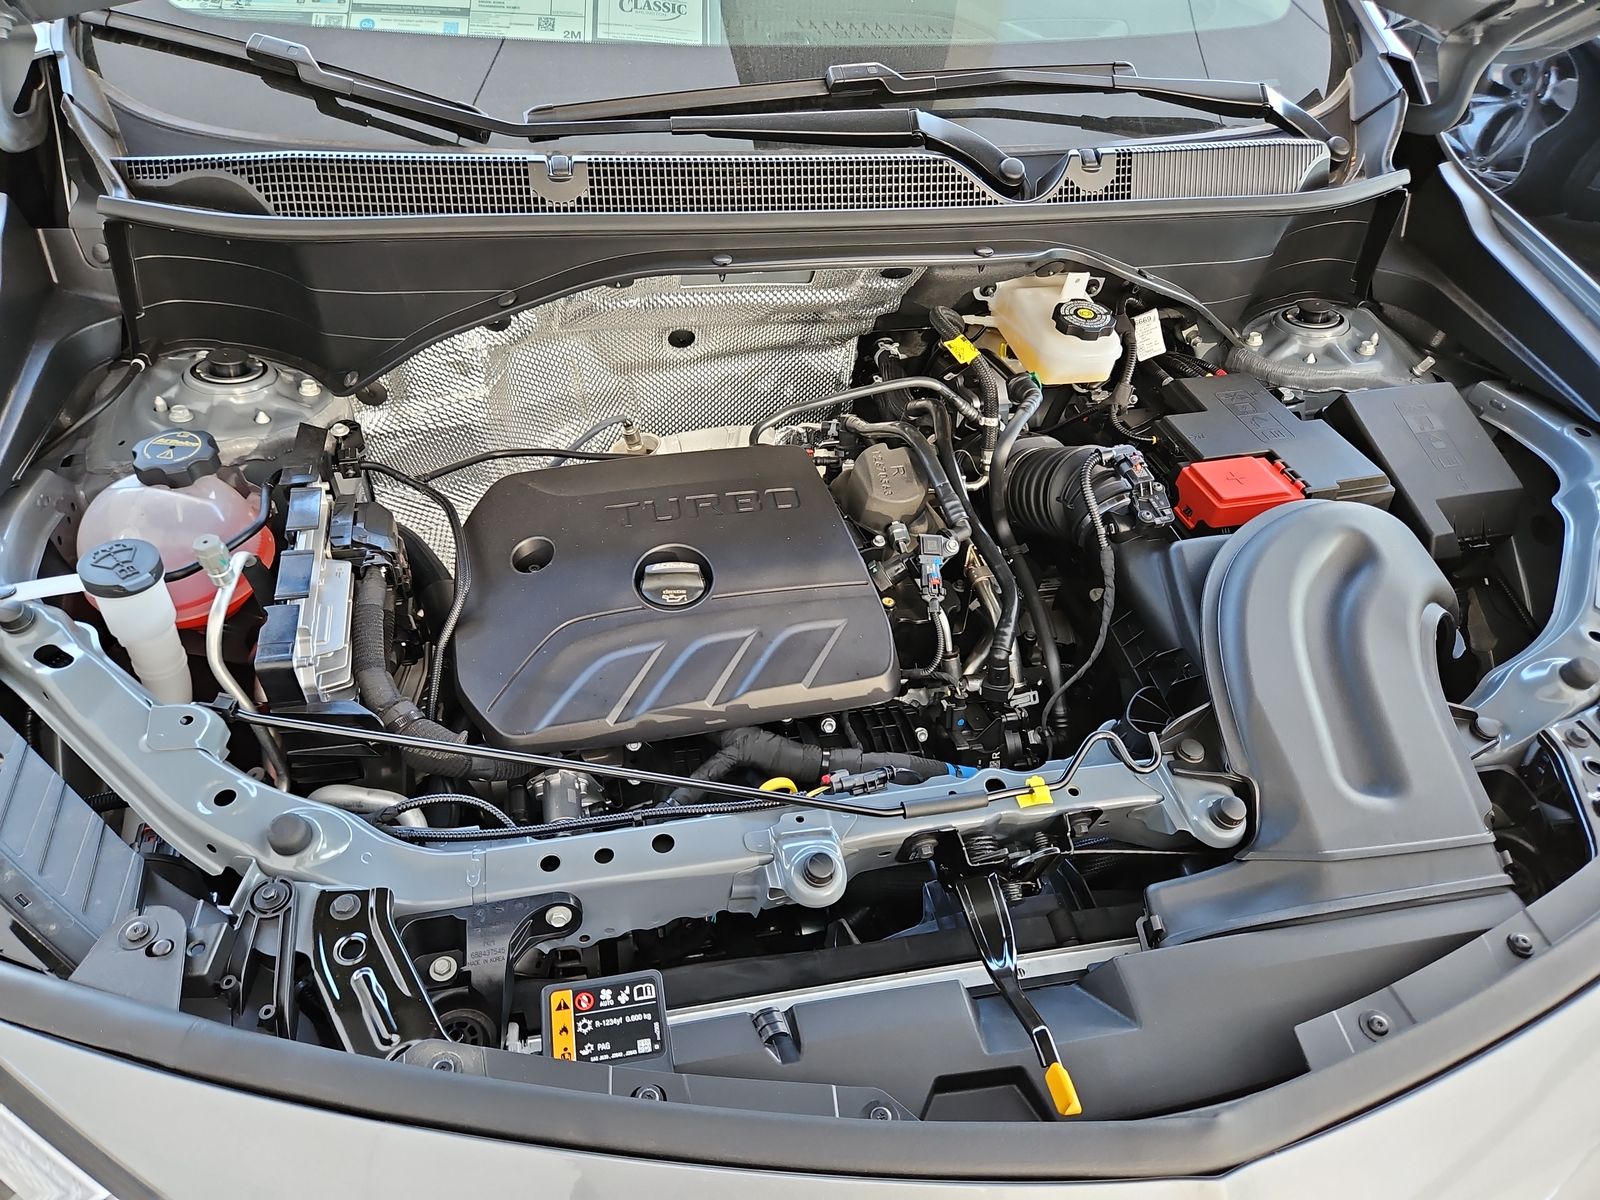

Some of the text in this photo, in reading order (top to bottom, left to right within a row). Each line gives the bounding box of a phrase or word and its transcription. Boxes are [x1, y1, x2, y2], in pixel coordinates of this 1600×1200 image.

[619, 0, 688, 16] CLASSIC
[563, 30, 582, 39] 2M
[890, 465, 906, 477] R
[604, 487, 800, 528] TURBO
[599, 999, 615, 1007] AUTO
[595, 1017, 622, 1027] R-1234yf
[597, 1042, 611, 1051] PAG
